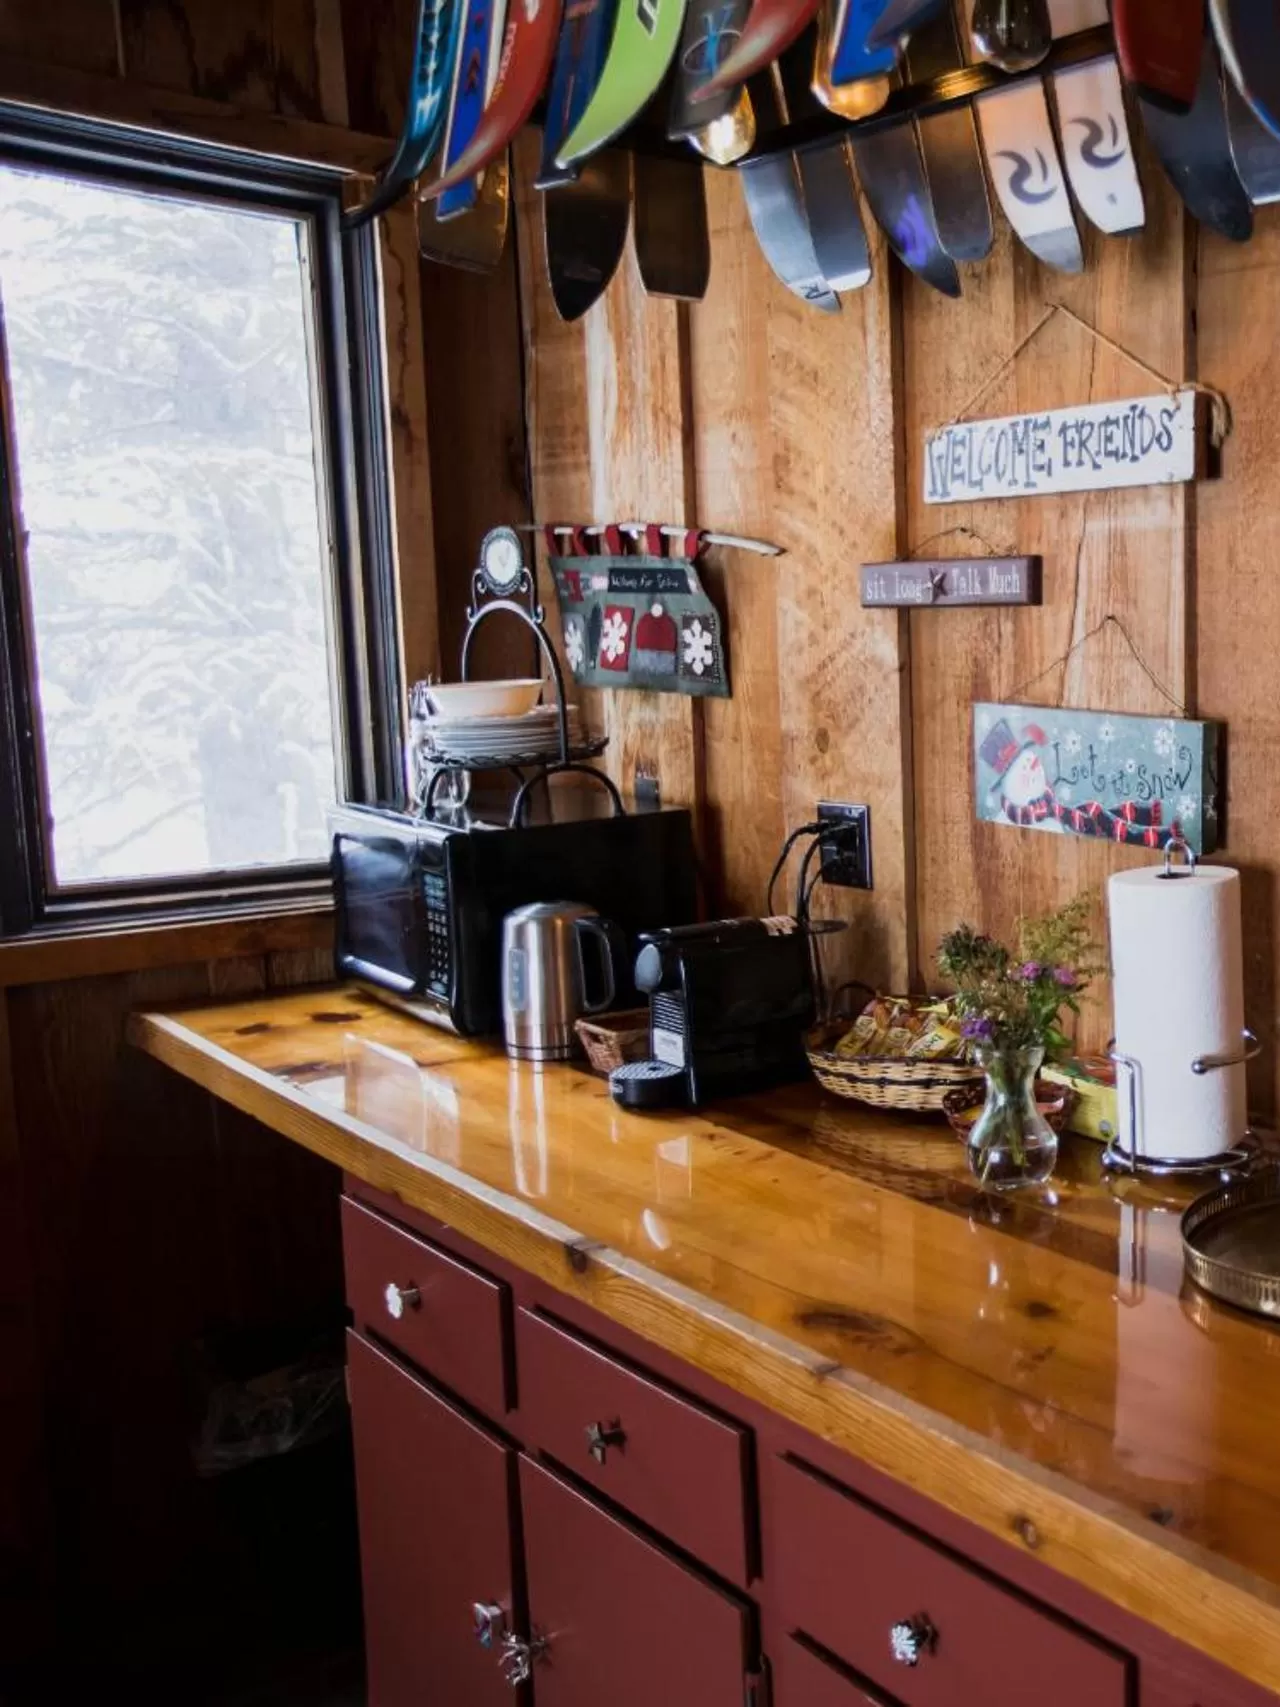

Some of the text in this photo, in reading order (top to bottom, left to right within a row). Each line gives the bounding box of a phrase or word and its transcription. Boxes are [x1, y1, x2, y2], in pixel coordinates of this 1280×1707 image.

[926, 403, 1180, 498] WELCOME FRIENDS
[866, 564, 1020, 603] sit long Talk Much
[1053, 741, 1193, 800] Let it Snow
